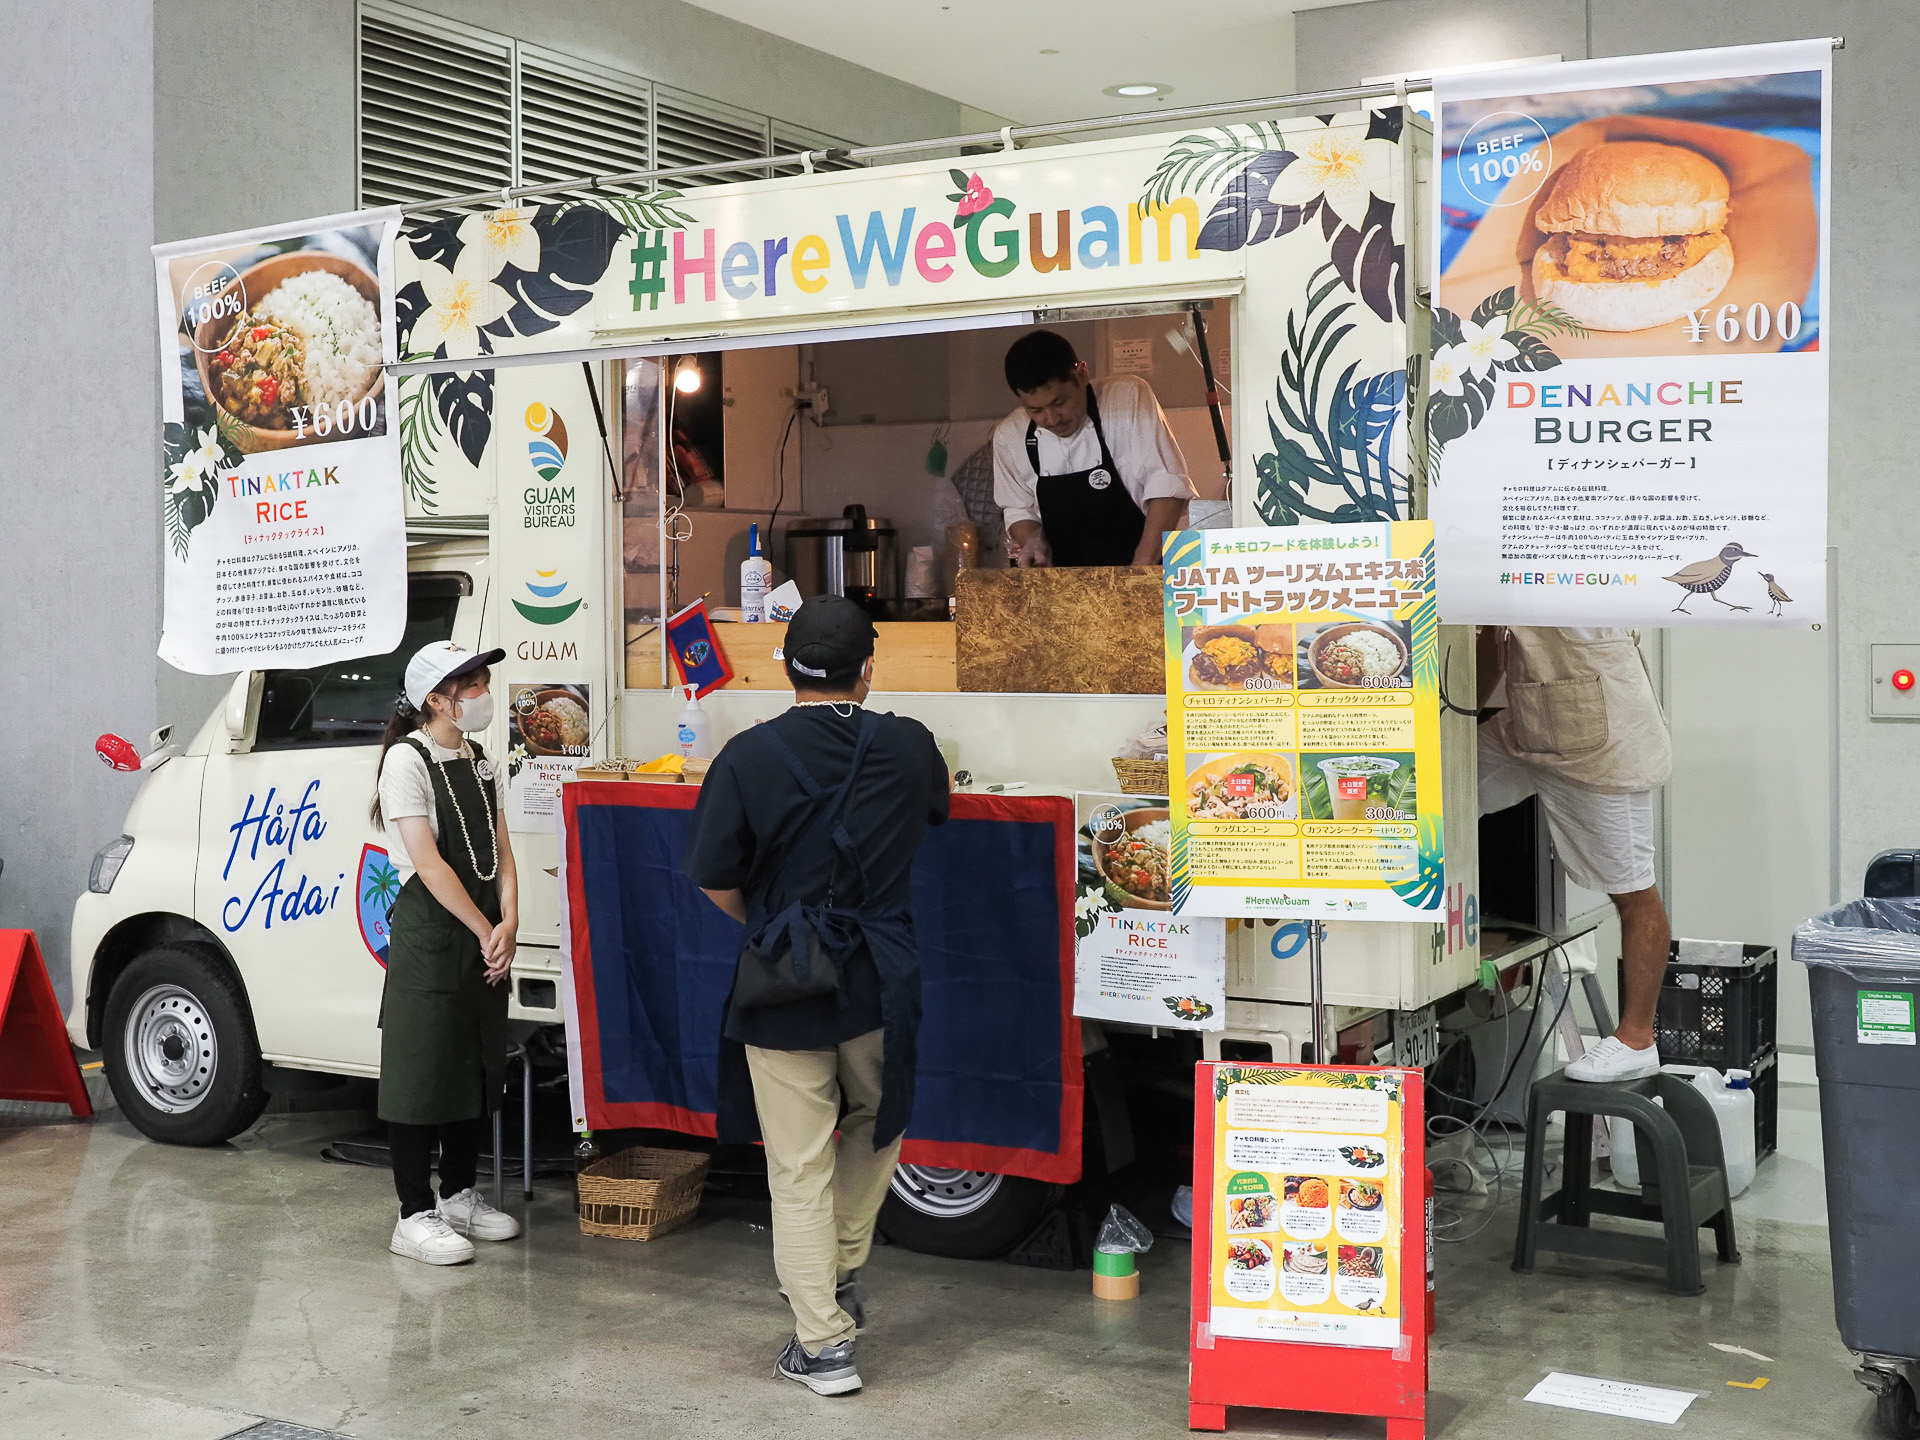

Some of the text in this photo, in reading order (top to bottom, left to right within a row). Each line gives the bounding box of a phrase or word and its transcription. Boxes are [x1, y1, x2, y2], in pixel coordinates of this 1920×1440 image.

[1477, 133, 1525, 156] BEEF
[1469, 150, 1544, 185] 100%
[629, 196, 1200, 311] #HereWeGuam
[194, 276, 227, 299] BEEF
[188, 291, 241, 328] 100%
[1682, 301, 1802, 343] ¥600
[1507, 380, 1743, 409] DENANCHE
[290, 396, 377, 441] ¥600
[1534, 417, 1713, 445] BURGER
[227, 466, 340, 498] TINAKTAK
[524, 486, 575, 504] GUAM
[256, 500, 308, 524] RICE
[524, 504, 575, 516] VISITORS
[524, 515, 575, 528] BUREAU
[1172, 558, 1425, 587] JATA ツーリズムエキスポ
[1500, 572, 1638, 586] #HEREWEGUAM
[1175, 587, 1425, 614] フードトラックメニュー
[517, 640, 578, 661] GUAM
[1244, 677, 1281, 690] 600円
[1361, 675, 1400, 689] 600円
[1097, 811, 1115, 820] BEEF
[1365, 806, 1405, 820] 300円
[1093, 819, 1122, 832] 100%
[223, 858, 344, 932] Adai
[1245, 895, 1310, 907] #HereWeGuam
[1107, 916, 1190, 935] TINAKTAK
[1128, 934, 1168, 949] RICE
[1100, 991, 1152, 1001] #HEREWEGUAM
